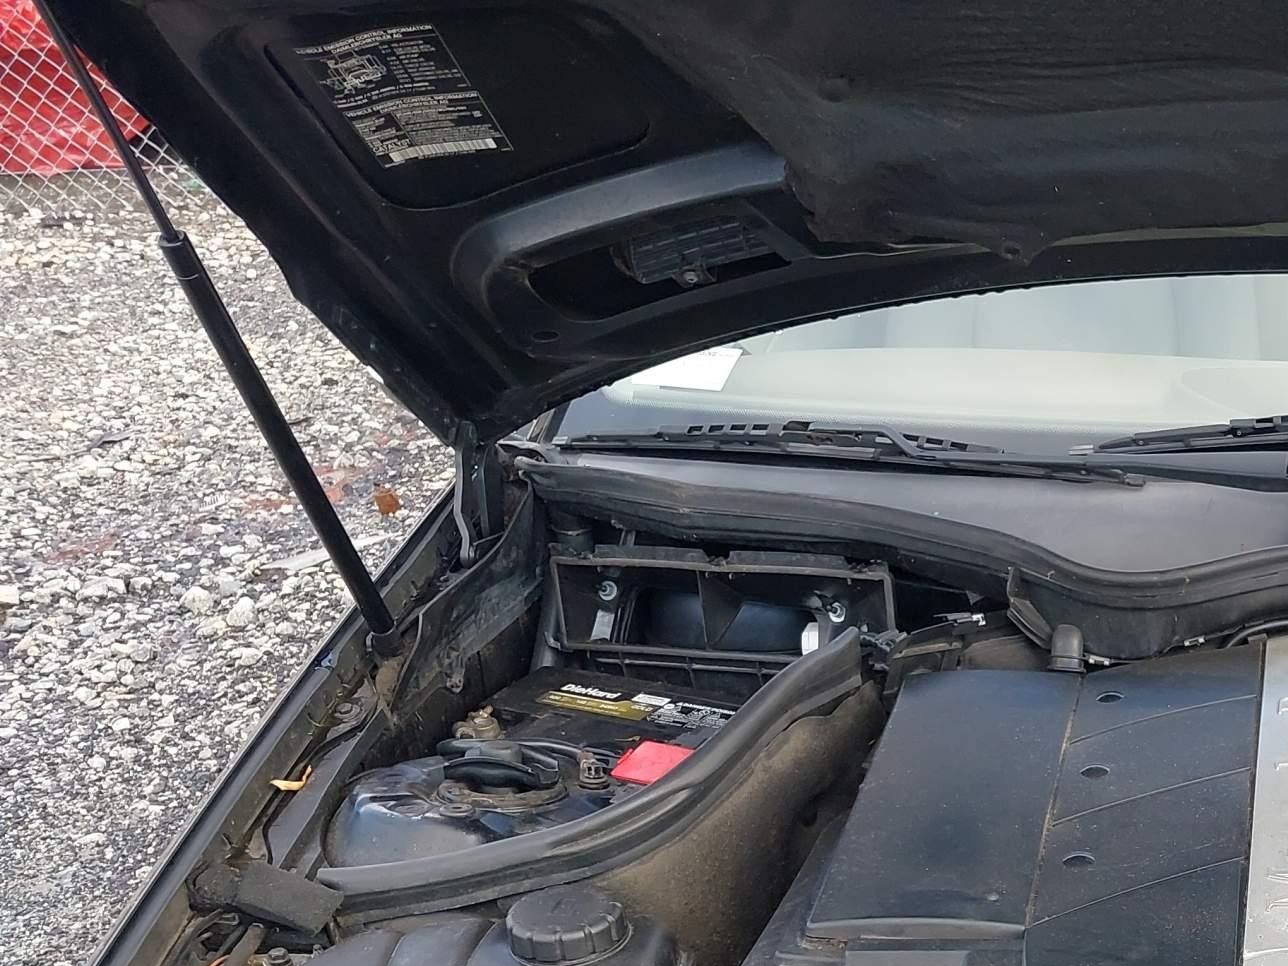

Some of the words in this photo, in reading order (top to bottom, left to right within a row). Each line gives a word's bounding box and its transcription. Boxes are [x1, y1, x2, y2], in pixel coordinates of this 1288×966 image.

[387, 24, 433, 34] INFORMATION
[372, 138, 411, 153] CATALYST
[560, 683, 621, 700] DieHard
